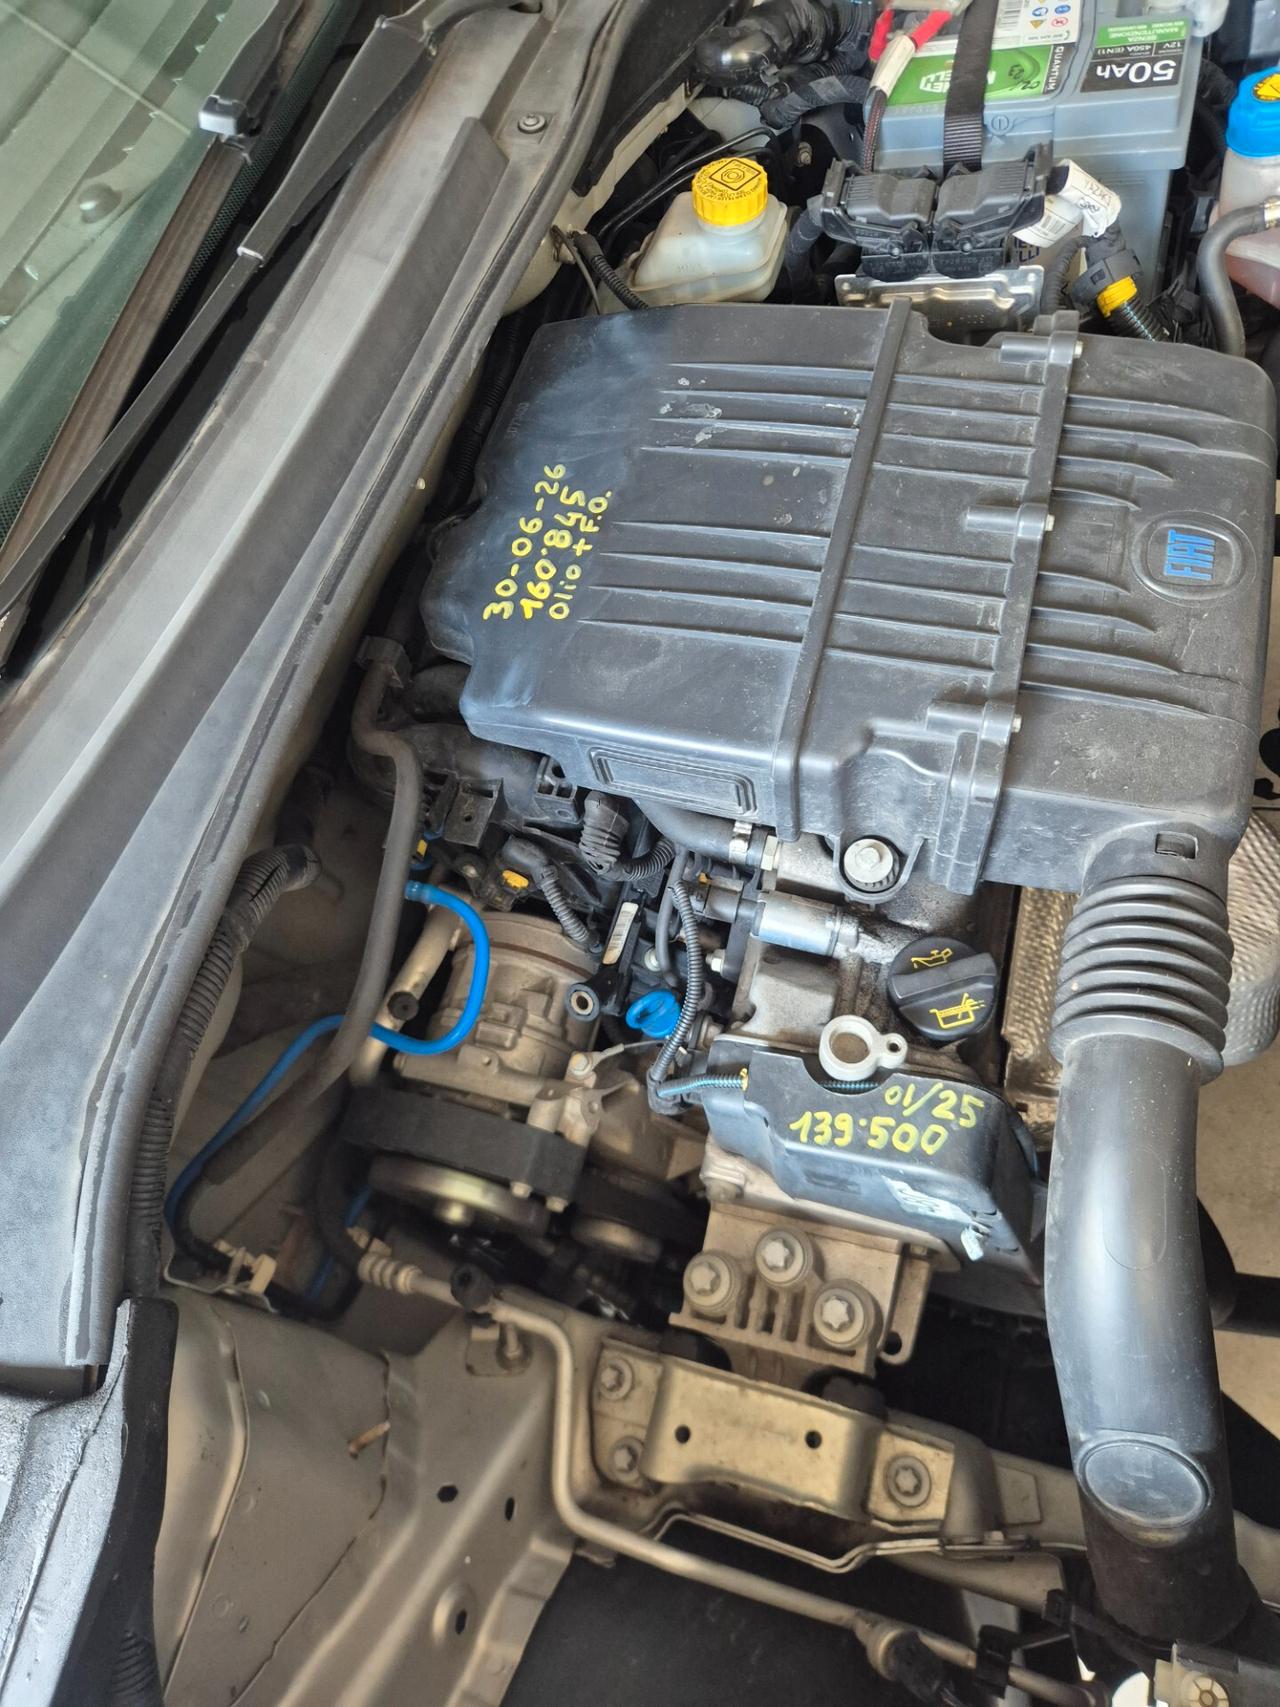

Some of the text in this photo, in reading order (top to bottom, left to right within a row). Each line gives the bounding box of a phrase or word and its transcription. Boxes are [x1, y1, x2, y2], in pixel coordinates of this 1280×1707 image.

[1047, 45, 1065, 91] QUANTUM
[1163, 41, 1181, 49] 12V
[1096, 60, 1177, 83] 50Ah
[1163, 529, 1216, 582] FIAT
[884, 1082, 985, 1129] 01/25
